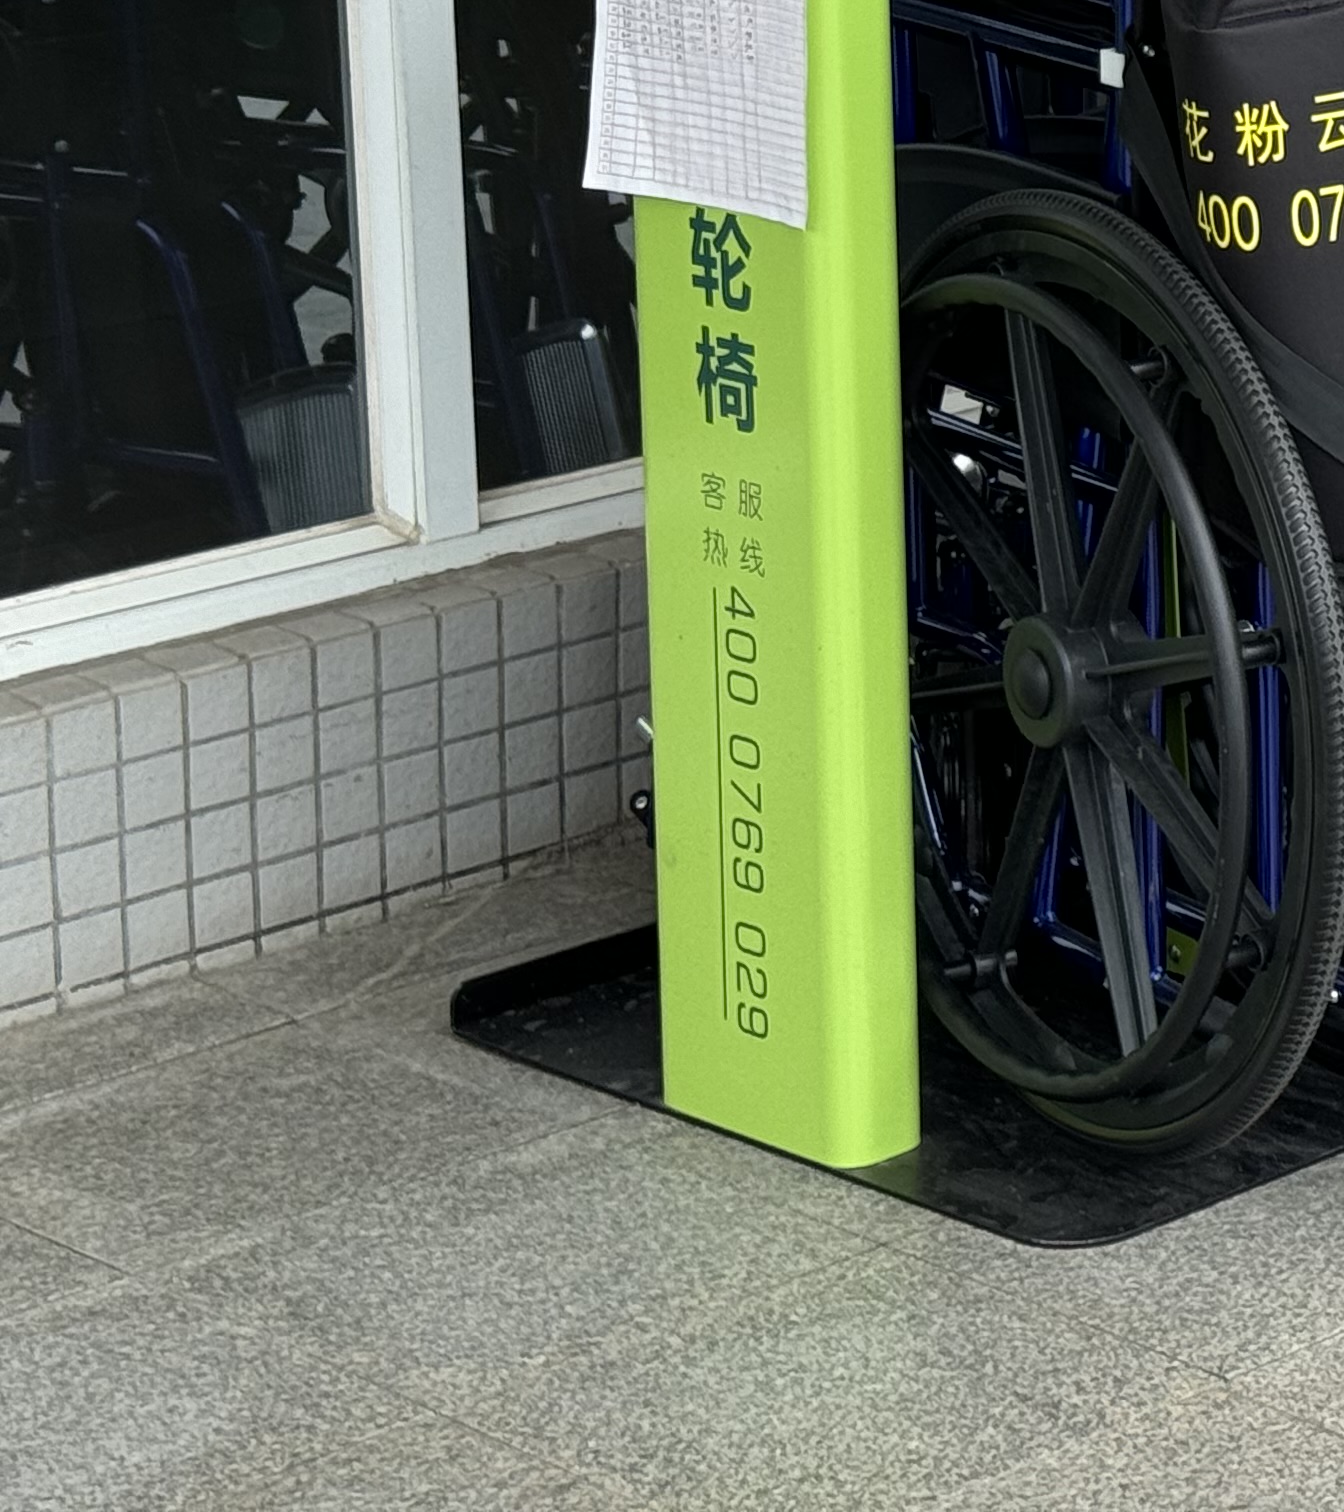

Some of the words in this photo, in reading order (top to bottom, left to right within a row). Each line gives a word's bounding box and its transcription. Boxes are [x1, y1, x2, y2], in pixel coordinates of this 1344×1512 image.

[1198, 189, 1260, 252] 400
[689, 206, 758, 434] 轮椅
[724, 584, 759, 706] 400
[729, 733, 764, 895] 0769
[734, 920, 770, 1040] 029
